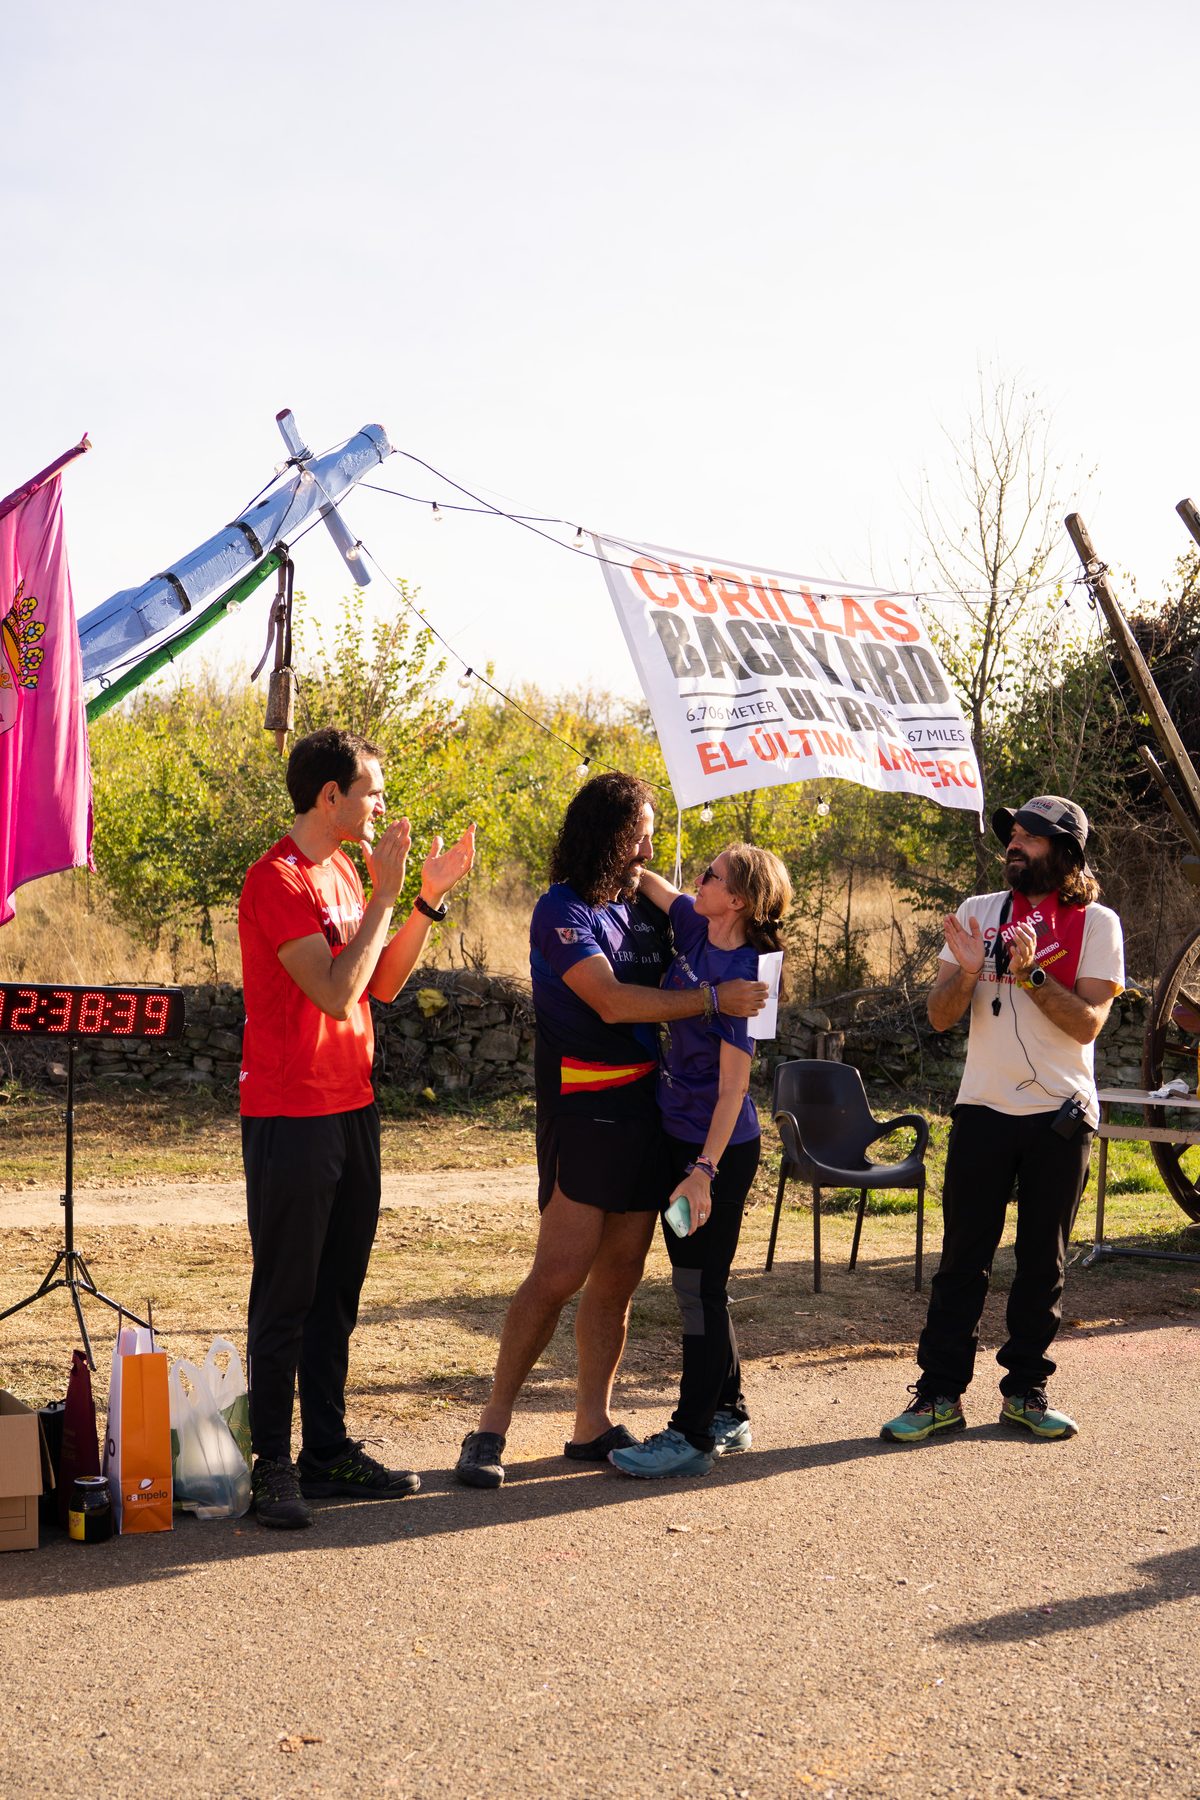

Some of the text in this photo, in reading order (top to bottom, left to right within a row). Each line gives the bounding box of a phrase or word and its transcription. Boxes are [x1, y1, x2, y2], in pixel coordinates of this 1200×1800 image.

[631, 556, 921, 643] CURILLAS
[649, 610, 950, 705] BACKYARD
[686, 700, 777, 722] 6.706 METER
[926, 729, 965, 742] MILES
[696, 741, 749, 775] EL
[126, 1490, 168, 1502] campelo
